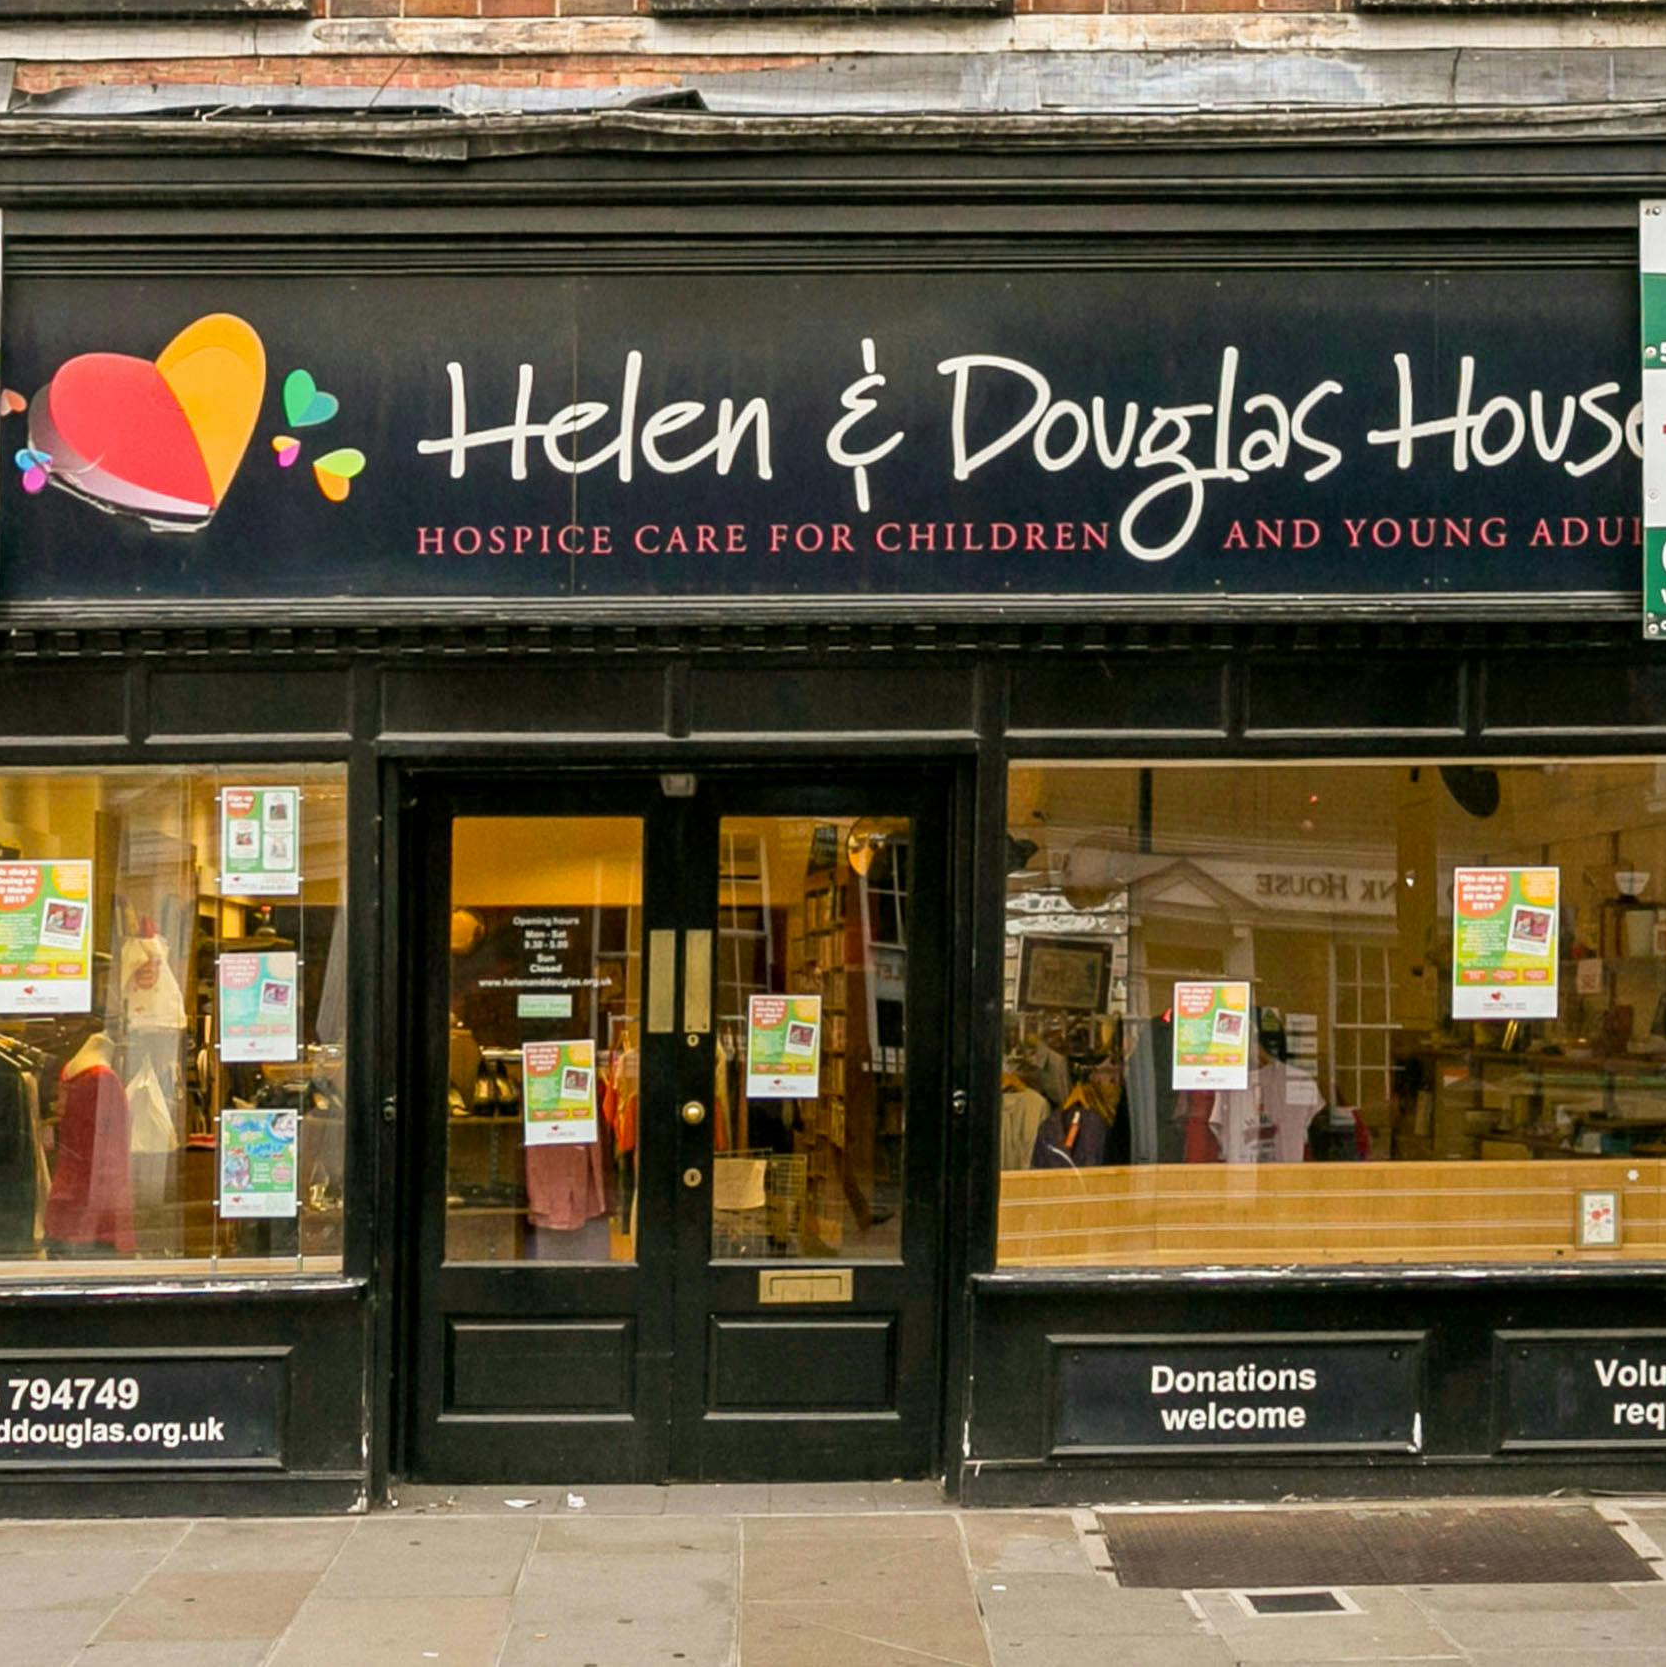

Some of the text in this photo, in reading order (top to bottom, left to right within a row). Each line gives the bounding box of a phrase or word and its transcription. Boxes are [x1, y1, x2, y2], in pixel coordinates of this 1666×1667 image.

[417, 350, 772, 482] Helen
[827, 338, 904, 512] &
[937, 347, 1343, 561] Douglas
[419, 525, 612, 554] HOSPICE
[635, 525, 746, 553] CARE
[771, 524, 854, 551] FOR
[876, 523, 1107, 551] CHILDREN
[1224, 520, 1320, 548] AND
[1345, 518, 1506, 547] YOUNG
[513, 917, 580, 927] Opening hours
[529, 964, 563, 974] Closed
[537, 954, 556, 963] Sun
[1152, 1364, 1316, 1393] Donations
[9, 1378, 138, 1410] 794749
[1161, 1402, 1305, 1430] welcome
